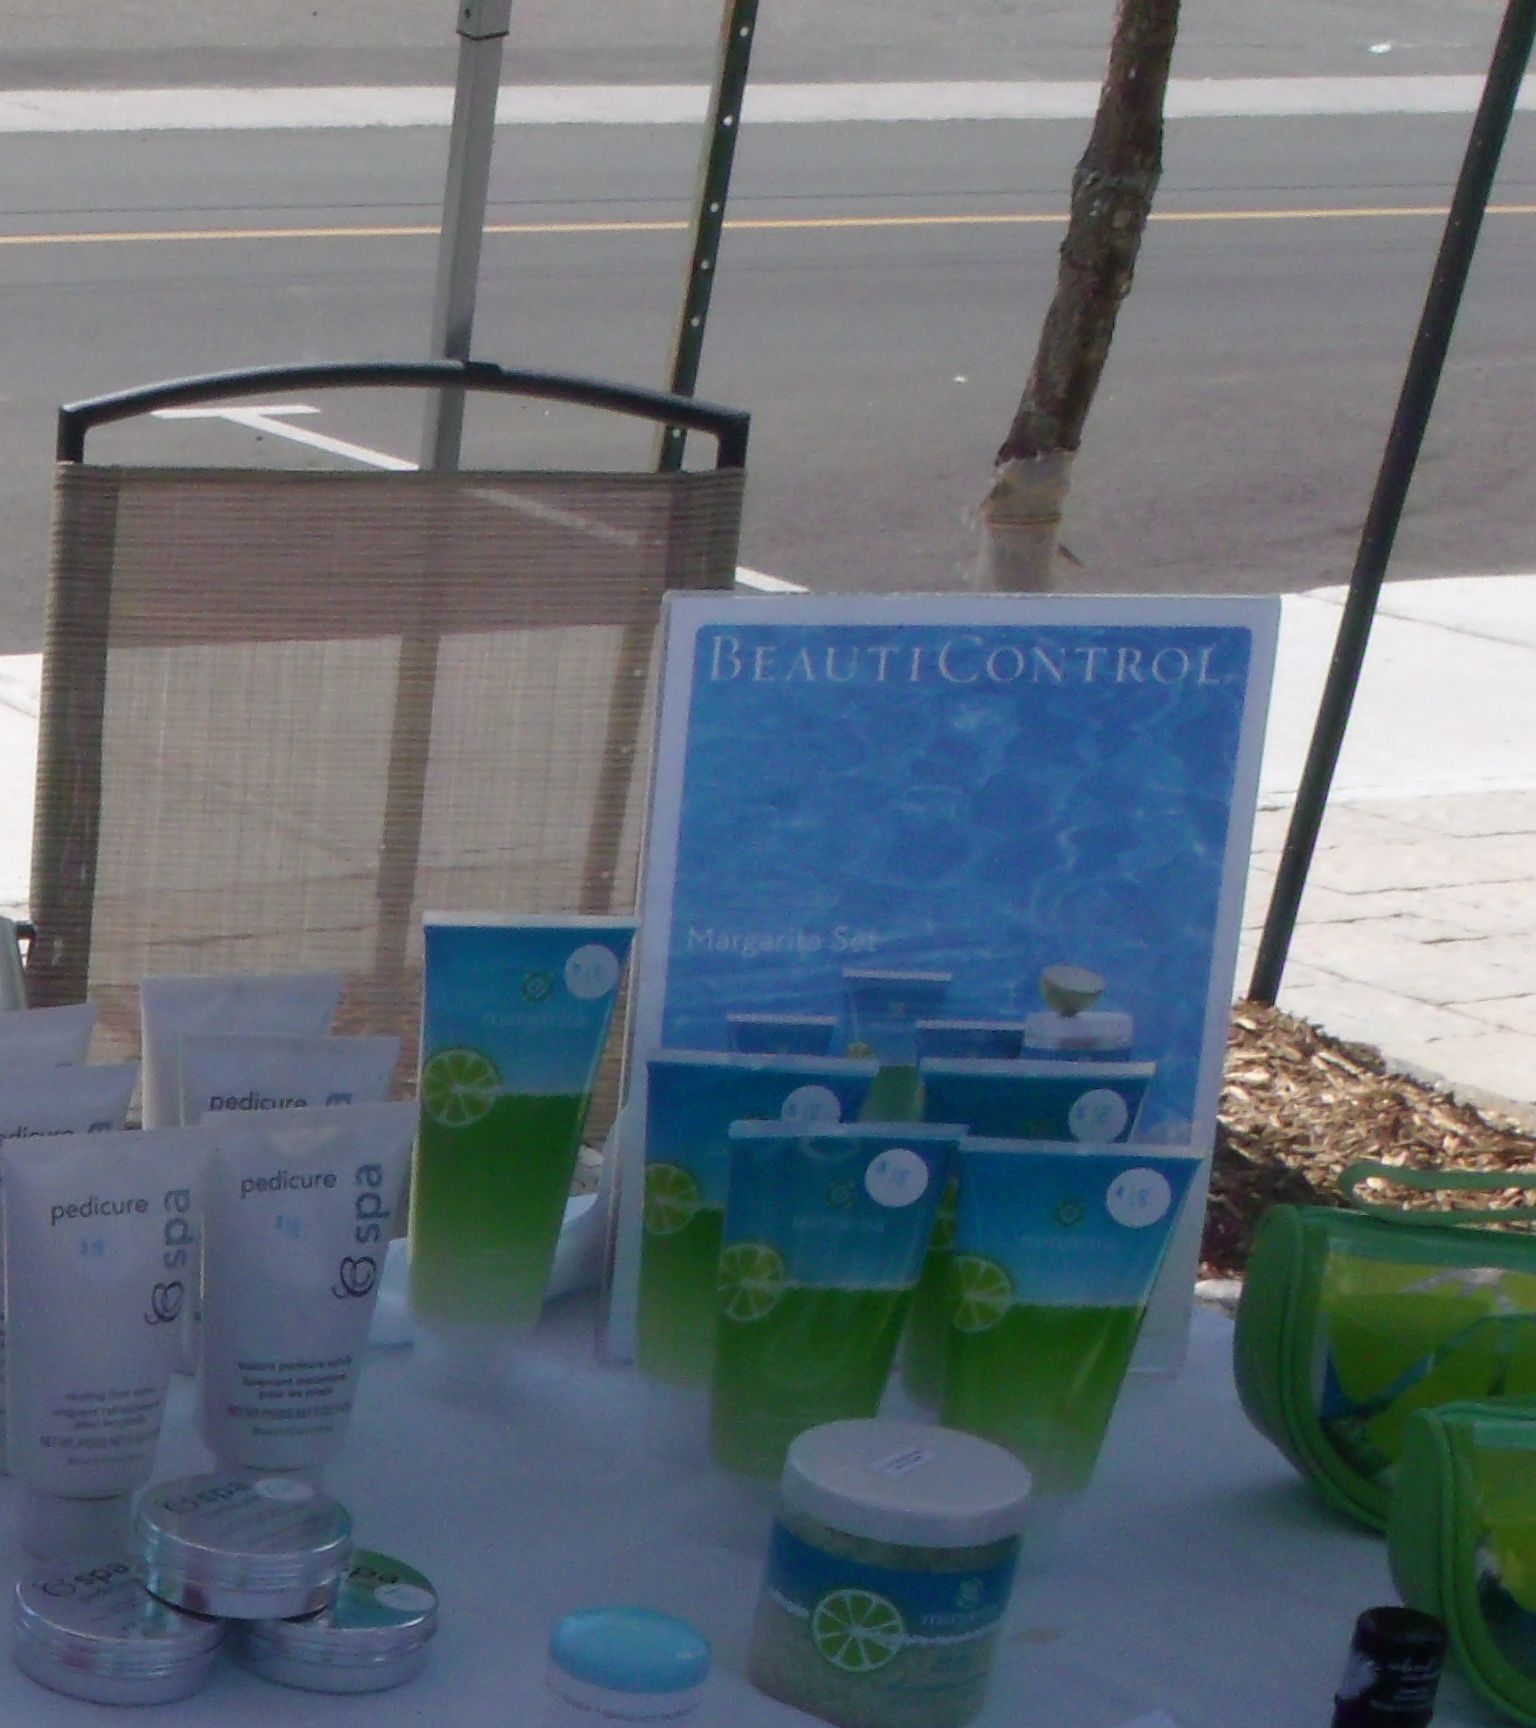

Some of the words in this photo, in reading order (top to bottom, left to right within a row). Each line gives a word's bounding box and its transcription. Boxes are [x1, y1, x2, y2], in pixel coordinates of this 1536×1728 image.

[710, 634, 1226, 686] BEAUTICONTROL
[689, 927, 822, 956] Margarita
[828, 927, 877, 953] Set
[240, 1169, 338, 1199] pedicure
[355, 1164, 390, 1244] spa
[51, 1196, 149, 1226] pedicure
[162, 1188, 196, 1270] spa
